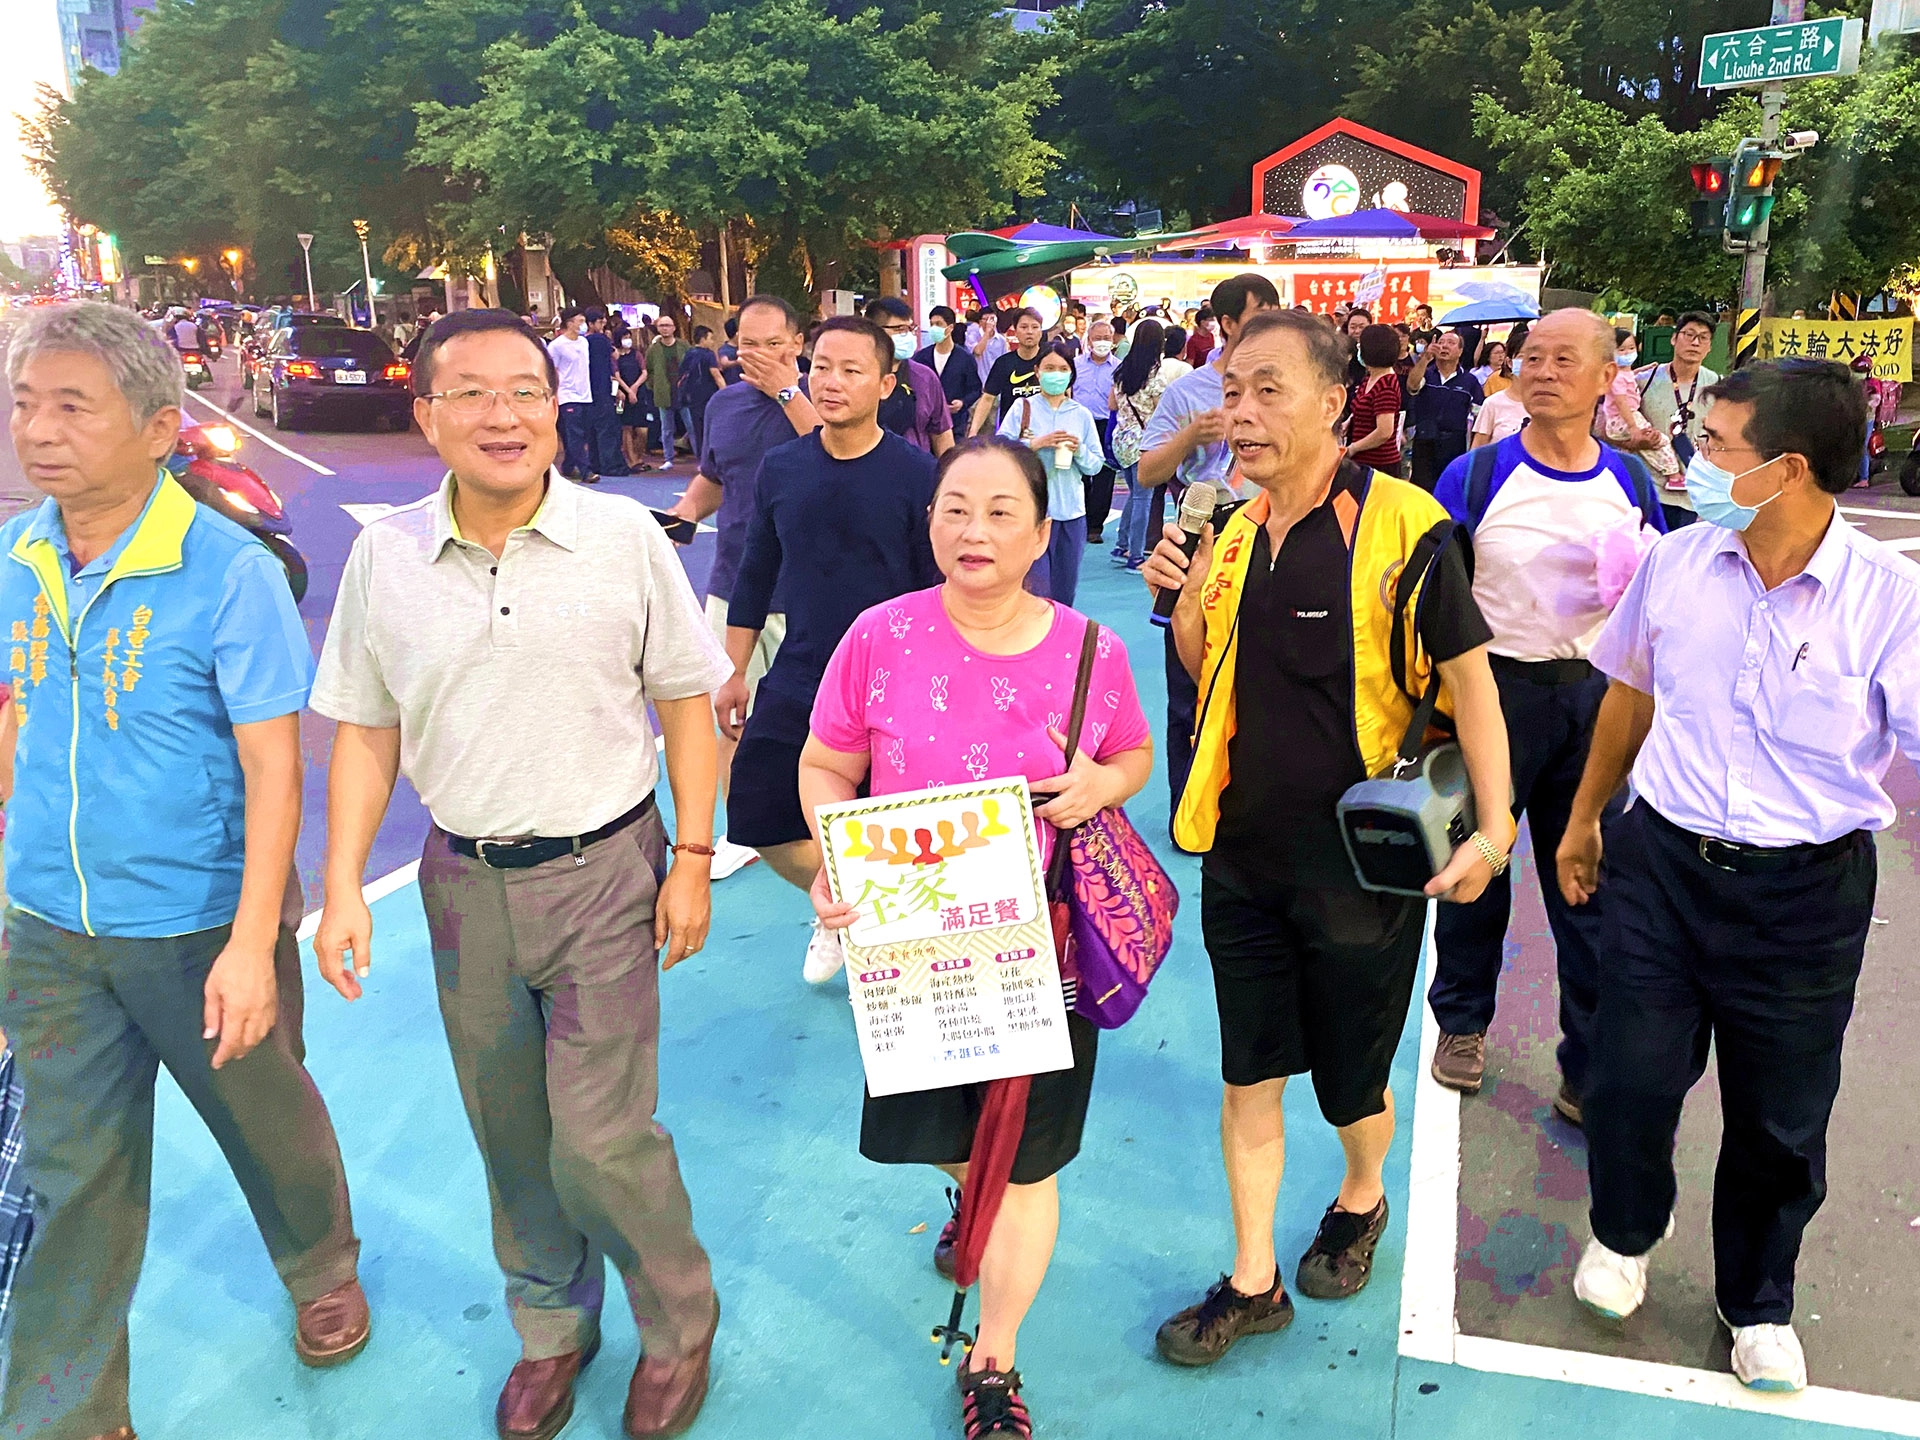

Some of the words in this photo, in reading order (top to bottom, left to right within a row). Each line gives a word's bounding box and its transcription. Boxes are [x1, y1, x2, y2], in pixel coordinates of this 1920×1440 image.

[1721, 26, 1821, 60] 六合二路
[1723, 58, 1764, 80] Liouhe
[1767, 54, 1791, 76] 2nd
[1779, 328, 1903, 359] 法輪大法好
[1873, 362, 1900, 377] OOD
[121, 604, 153, 691] 台電工會
[852, 862, 957, 932] 全家
[940, 898, 1021, 931] 滿足餐
[932, 987, 977, 1002] 排骨酥湯
[869, 1012, 903, 1026] 海產粥
[871, 1026, 905, 1039] 廣東粥
[941, 1026, 995, 1042] 大腸包小腸
